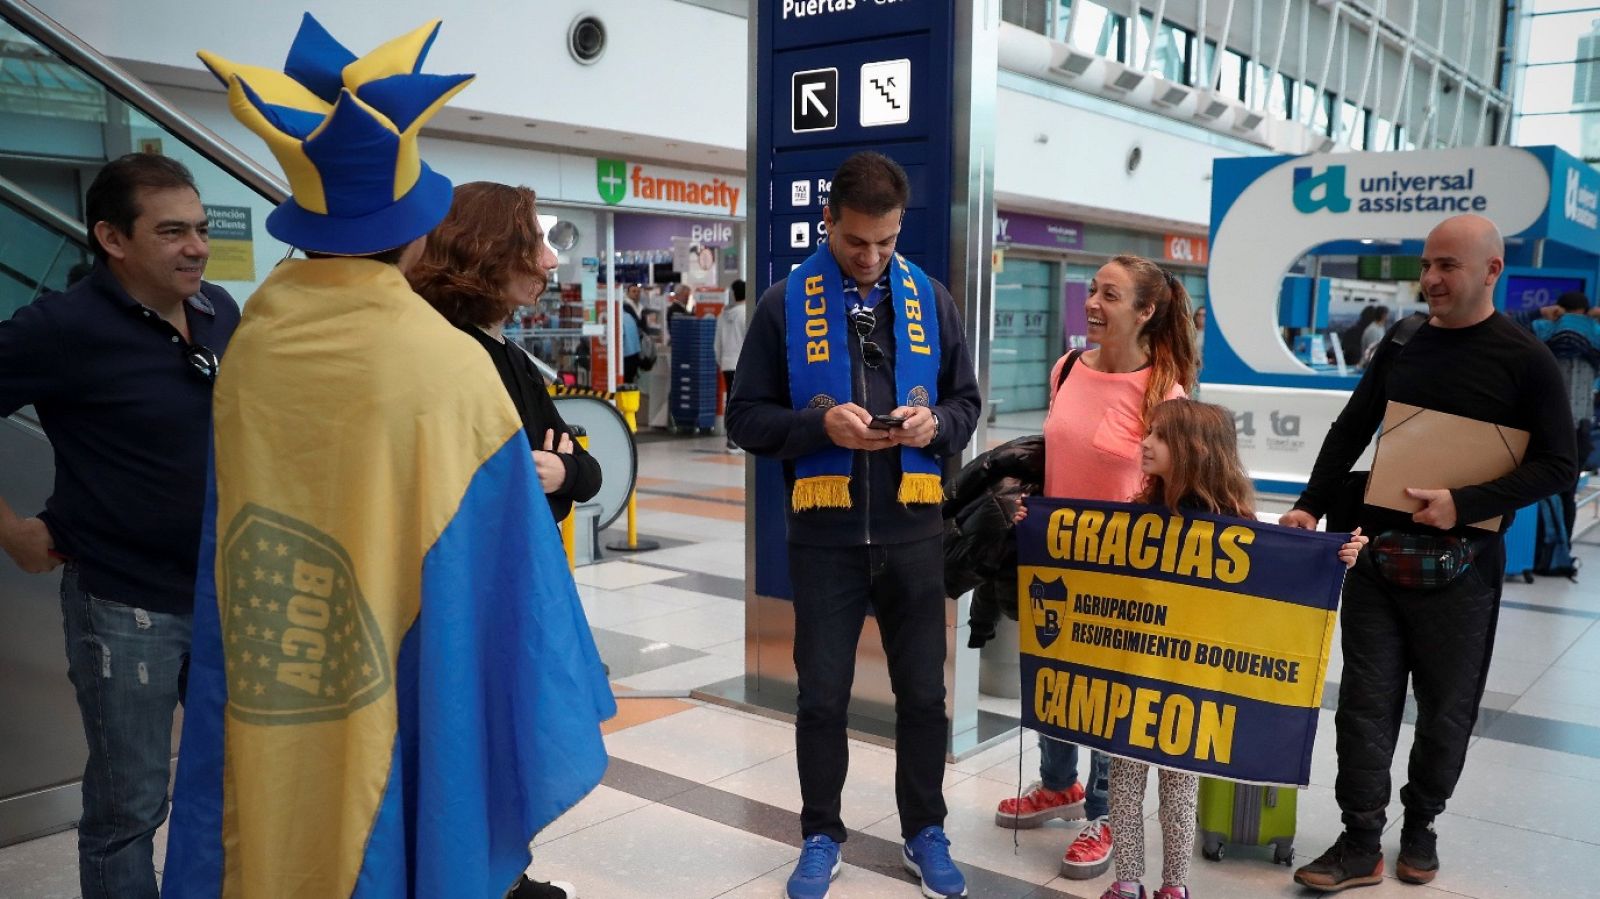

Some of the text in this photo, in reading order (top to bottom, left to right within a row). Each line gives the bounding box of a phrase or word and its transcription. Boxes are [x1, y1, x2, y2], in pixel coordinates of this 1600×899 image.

[782, 0, 857, 20] Puertas
[631, 165, 740, 217] farmacity
[818, 179, 832, 192] Re
[1360, 168, 1475, 195] universal
[207, 208, 246, 220] Atención
[1358, 192, 1487, 213] assistance
[216, 220, 247, 230] Cliente
[691, 223, 733, 242] Belle
[1170, 237, 1194, 261] GOL
[805, 274, 831, 365] BOCA
[1046, 508, 1256, 585] GRACIAS
[1073, 593, 1168, 627] AGRUPACION
[1071, 621, 1301, 684] RESURGIMIENTO BOQUENSE
[1034, 666, 1237, 765] CAMPEON
